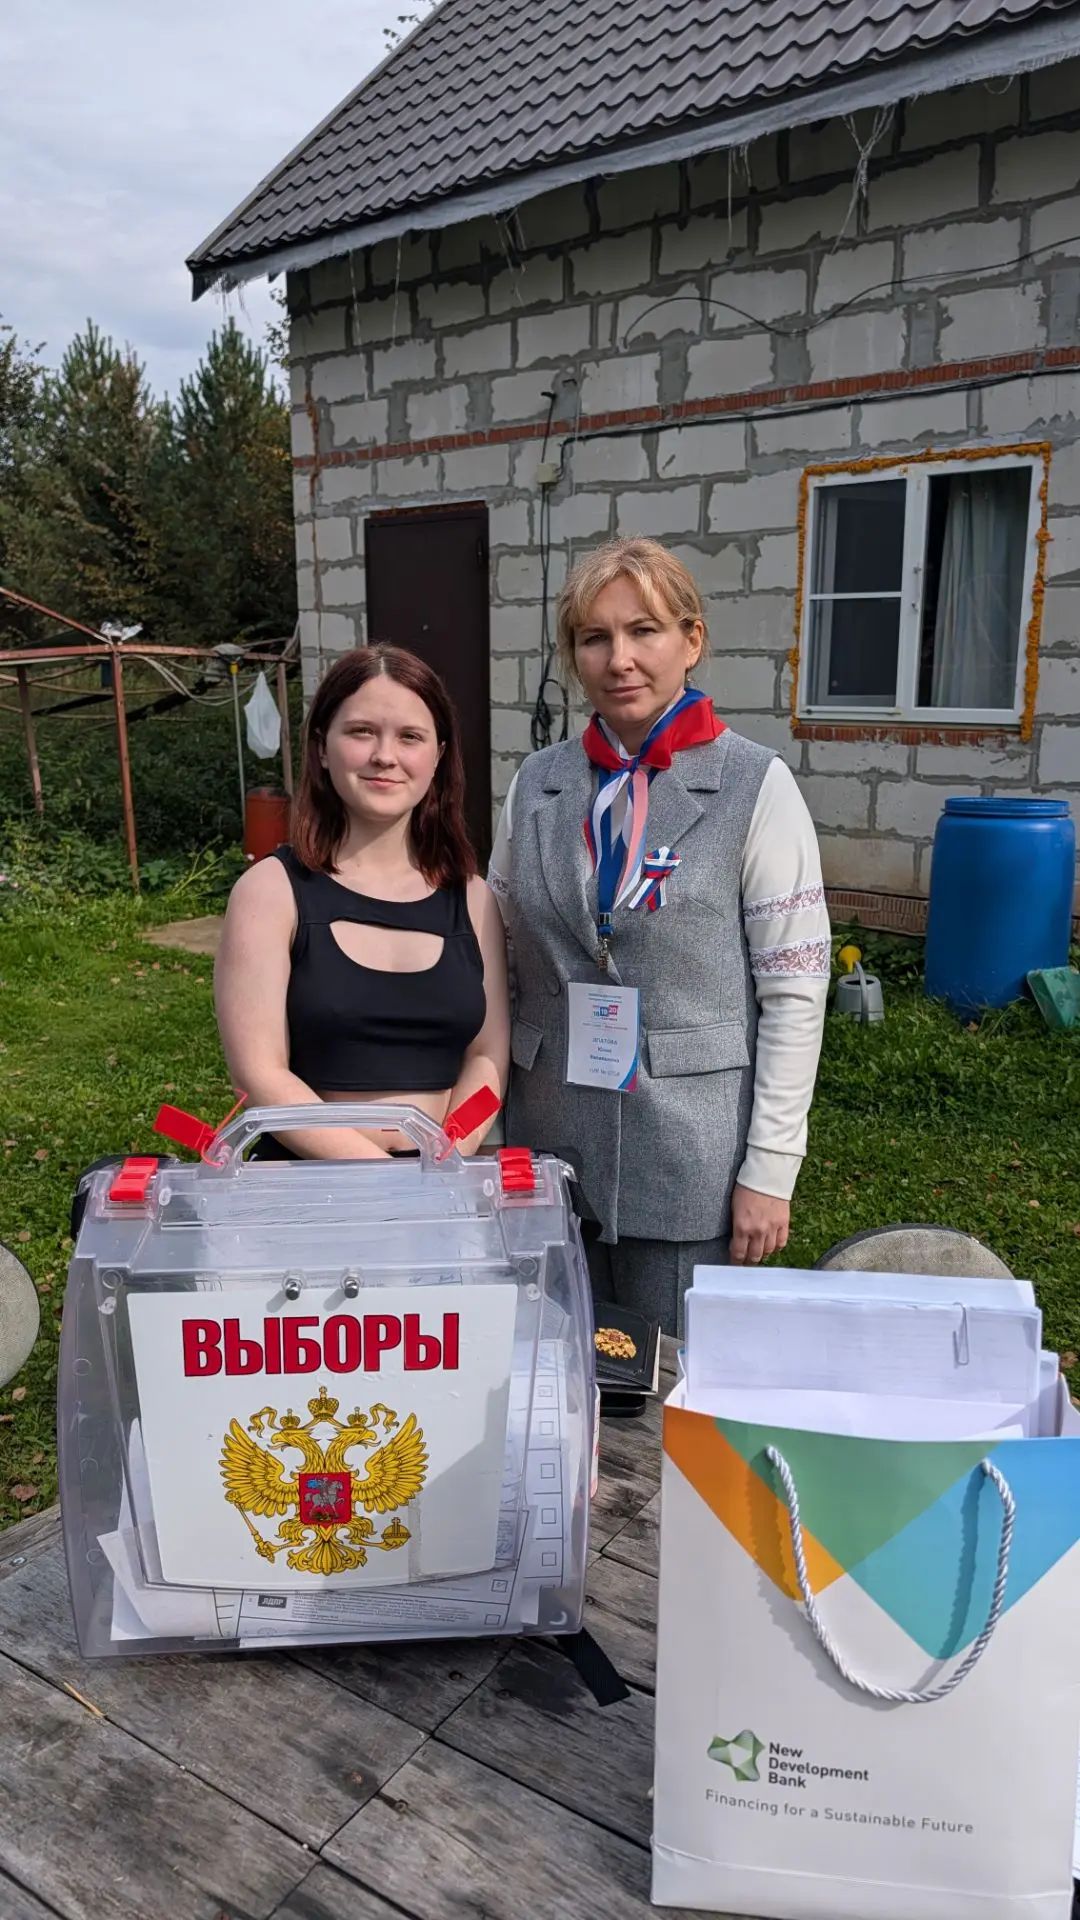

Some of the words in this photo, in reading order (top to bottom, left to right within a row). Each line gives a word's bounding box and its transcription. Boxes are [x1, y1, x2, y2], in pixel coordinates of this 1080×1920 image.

[182, 1313, 459, 1377] ВЫБОРЫ
[769, 1742, 803, 1758] New
[768, 1757, 869, 1781] Development
[768, 1772, 807, 1788] Bank
[705, 1789, 778, 1816] Financing
[784, 1803, 806, 1816] for
[811, 1808, 819, 1818] a
[824, 1808, 916, 1829] Sustainable
[921, 1817, 974, 1834] Future
